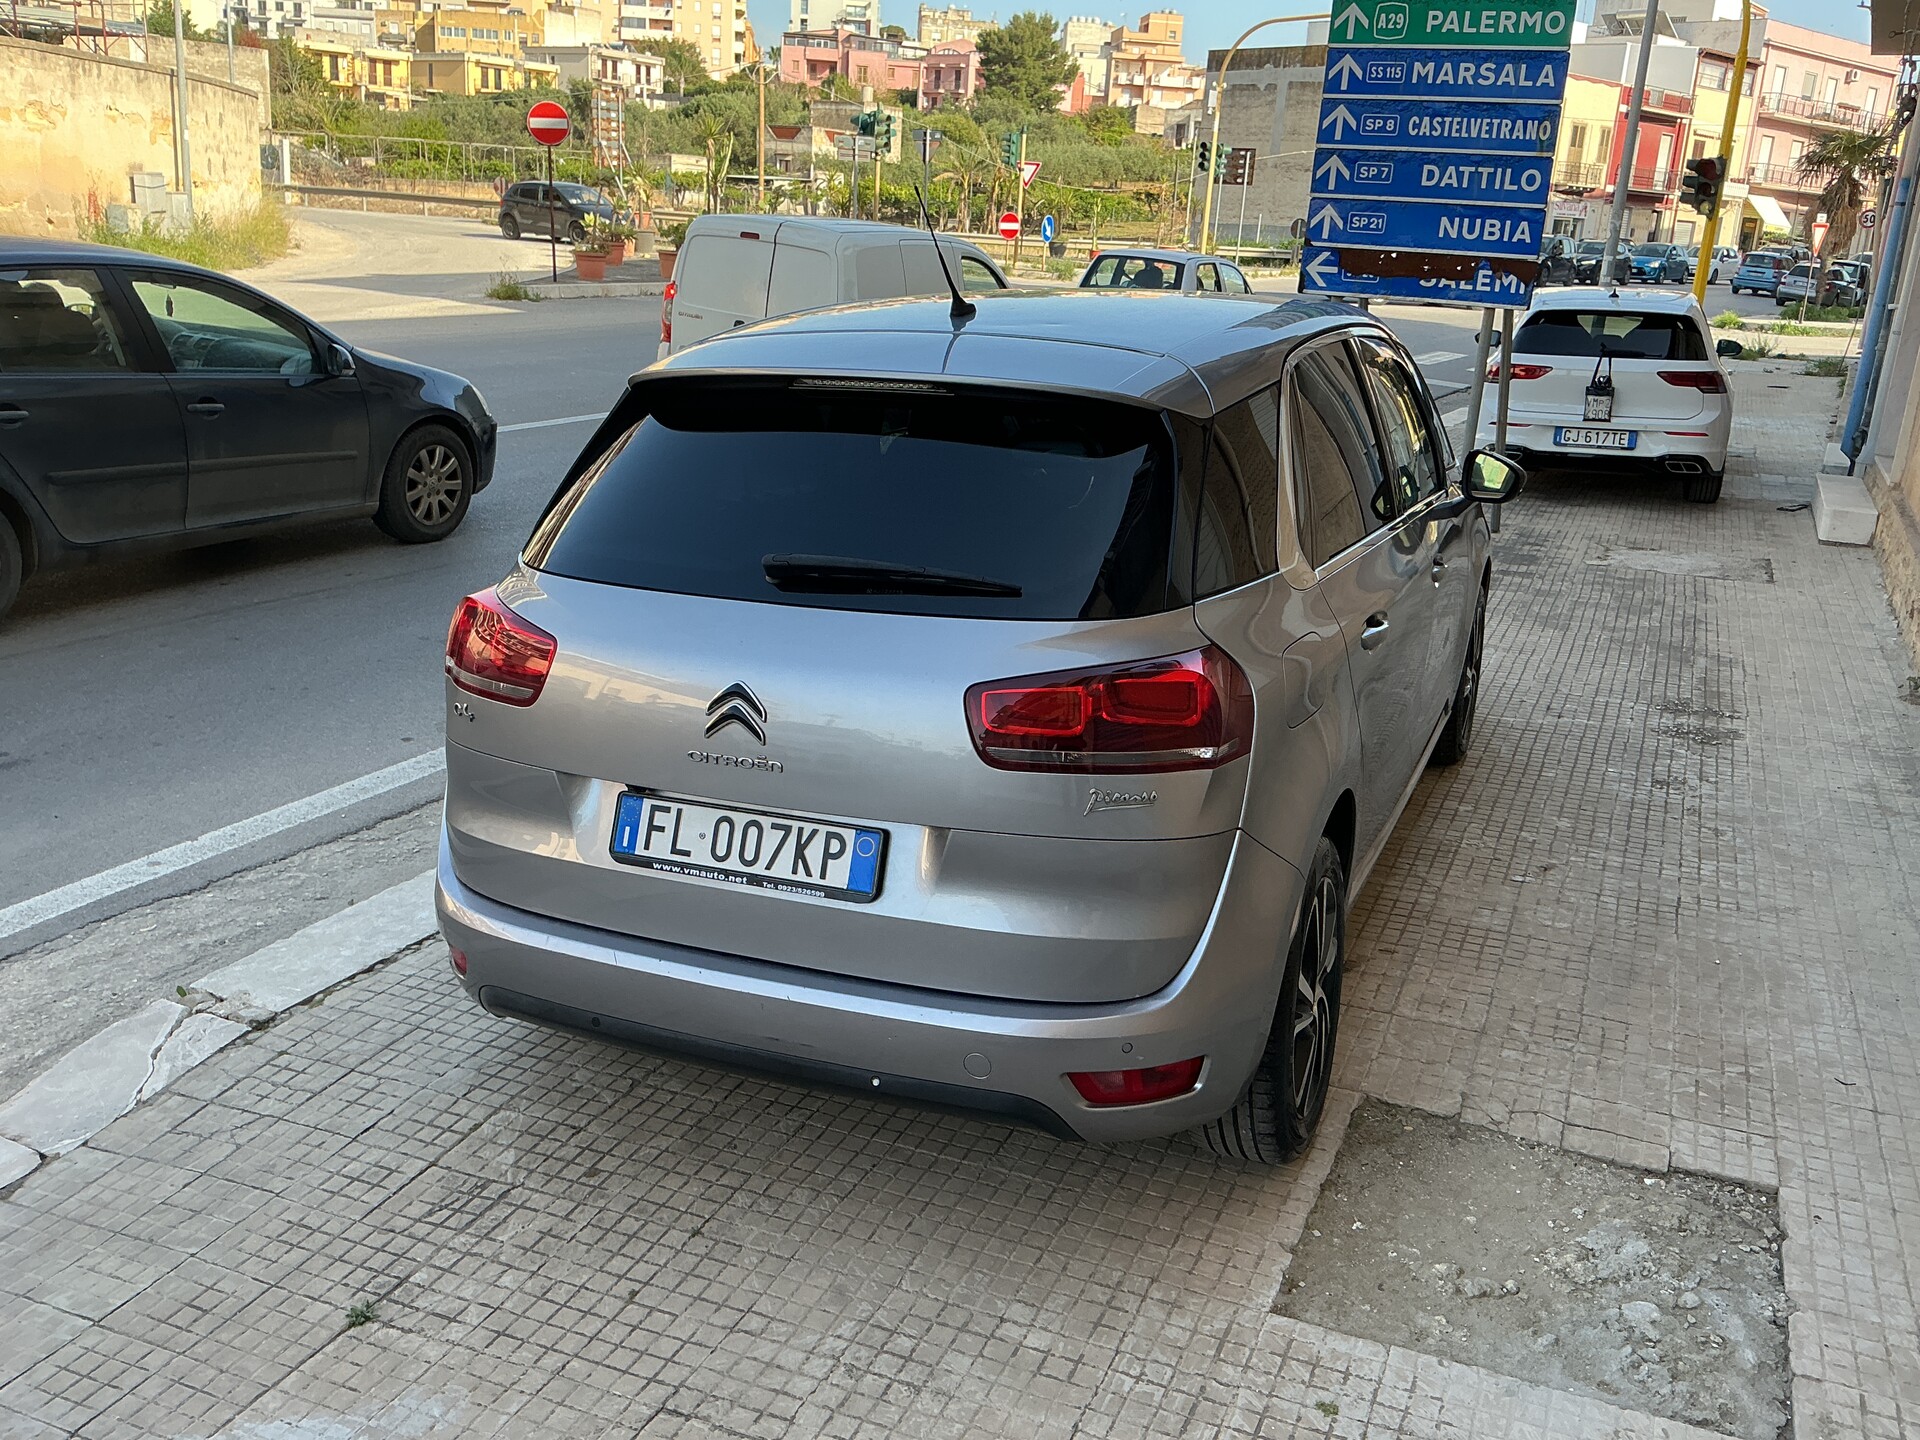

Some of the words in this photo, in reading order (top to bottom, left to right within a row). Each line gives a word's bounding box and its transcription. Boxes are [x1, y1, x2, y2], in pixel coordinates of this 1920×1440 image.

[1377, 12, 1404, 29] A29
[1426, 10, 1566, 34] PALERMO
[1370, 66, 1383, 78] SS
[1386, 66, 1402, 79] 115
[1411, 61, 1555, 88] MARSALA
[1365, 119, 1384, 131] SP
[1386, 120, 1394, 132] 8
[1408, 115, 1551, 141] CASTELVETRANO
[1359, 166, 1378, 178] SP
[1380, 167, 1388, 179] 7
[1420, 164, 1542, 192] DATTILO
[1438, 216, 1531, 244] NUBIA
[1863, 214, 1875, 223] 50
[652, 862, 748, 884] www.vmauto.net
[762, 881, 776, 889] Tel.
